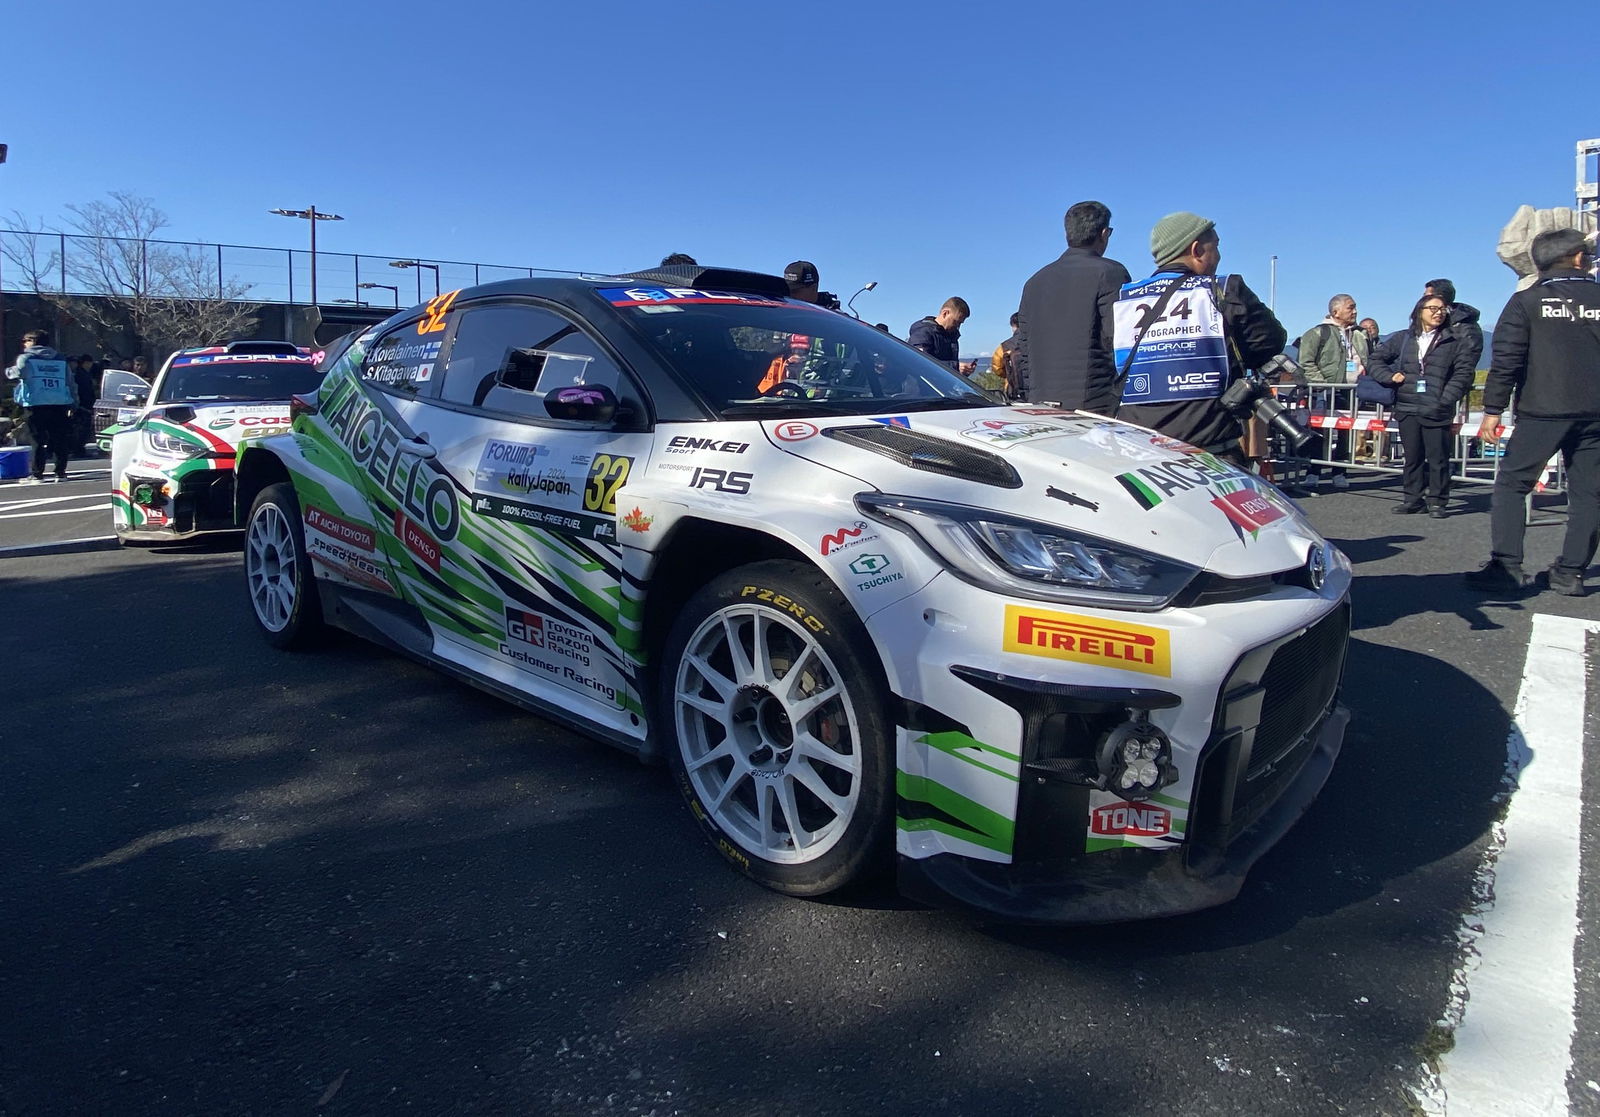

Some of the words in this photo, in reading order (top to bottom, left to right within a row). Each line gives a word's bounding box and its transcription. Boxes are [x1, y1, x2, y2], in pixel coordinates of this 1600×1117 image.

[418, 290, 460, 336] 32
[42, 378, 60, 389] 181
[1167, 371, 1221, 385] WRC
[487, 442, 538, 468] FORUM8
[665, 447, 696, 455] Sport
[668, 435, 751, 454] ENKEI
[658, 463, 694, 472] MOTORSPORT
[584, 453, 631, 514] 32
[688, 467, 754, 495] IRS
[501, 504, 521, 517] 100%
[520, 508, 564, 527] FOSSIL-FREE
[562, 519, 582, 531] FUEL
[1239, 498, 1272, 516] DENSO
[308, 510, 321, 524] AT
[320, 518, 340, 534] AICHI
[340, 525, 372, 546] TOYOTA
[408, 529, 437, 561] DENSO
[857, 572, 904, 592] TSUCHIYA
[508, 619, 544, 647] GR
[545, 618, 593, 645] TOYOTA
[547, 631, 590, 654] GAZOO
[1016, 614, 1156, 666] PIRELLI
[548, 641, 590, 667] Racing
[499, 643, 561, 675] Customer
[563, 666, 616, 702] Racing
[1098, 807, 1166, 833] TONE
